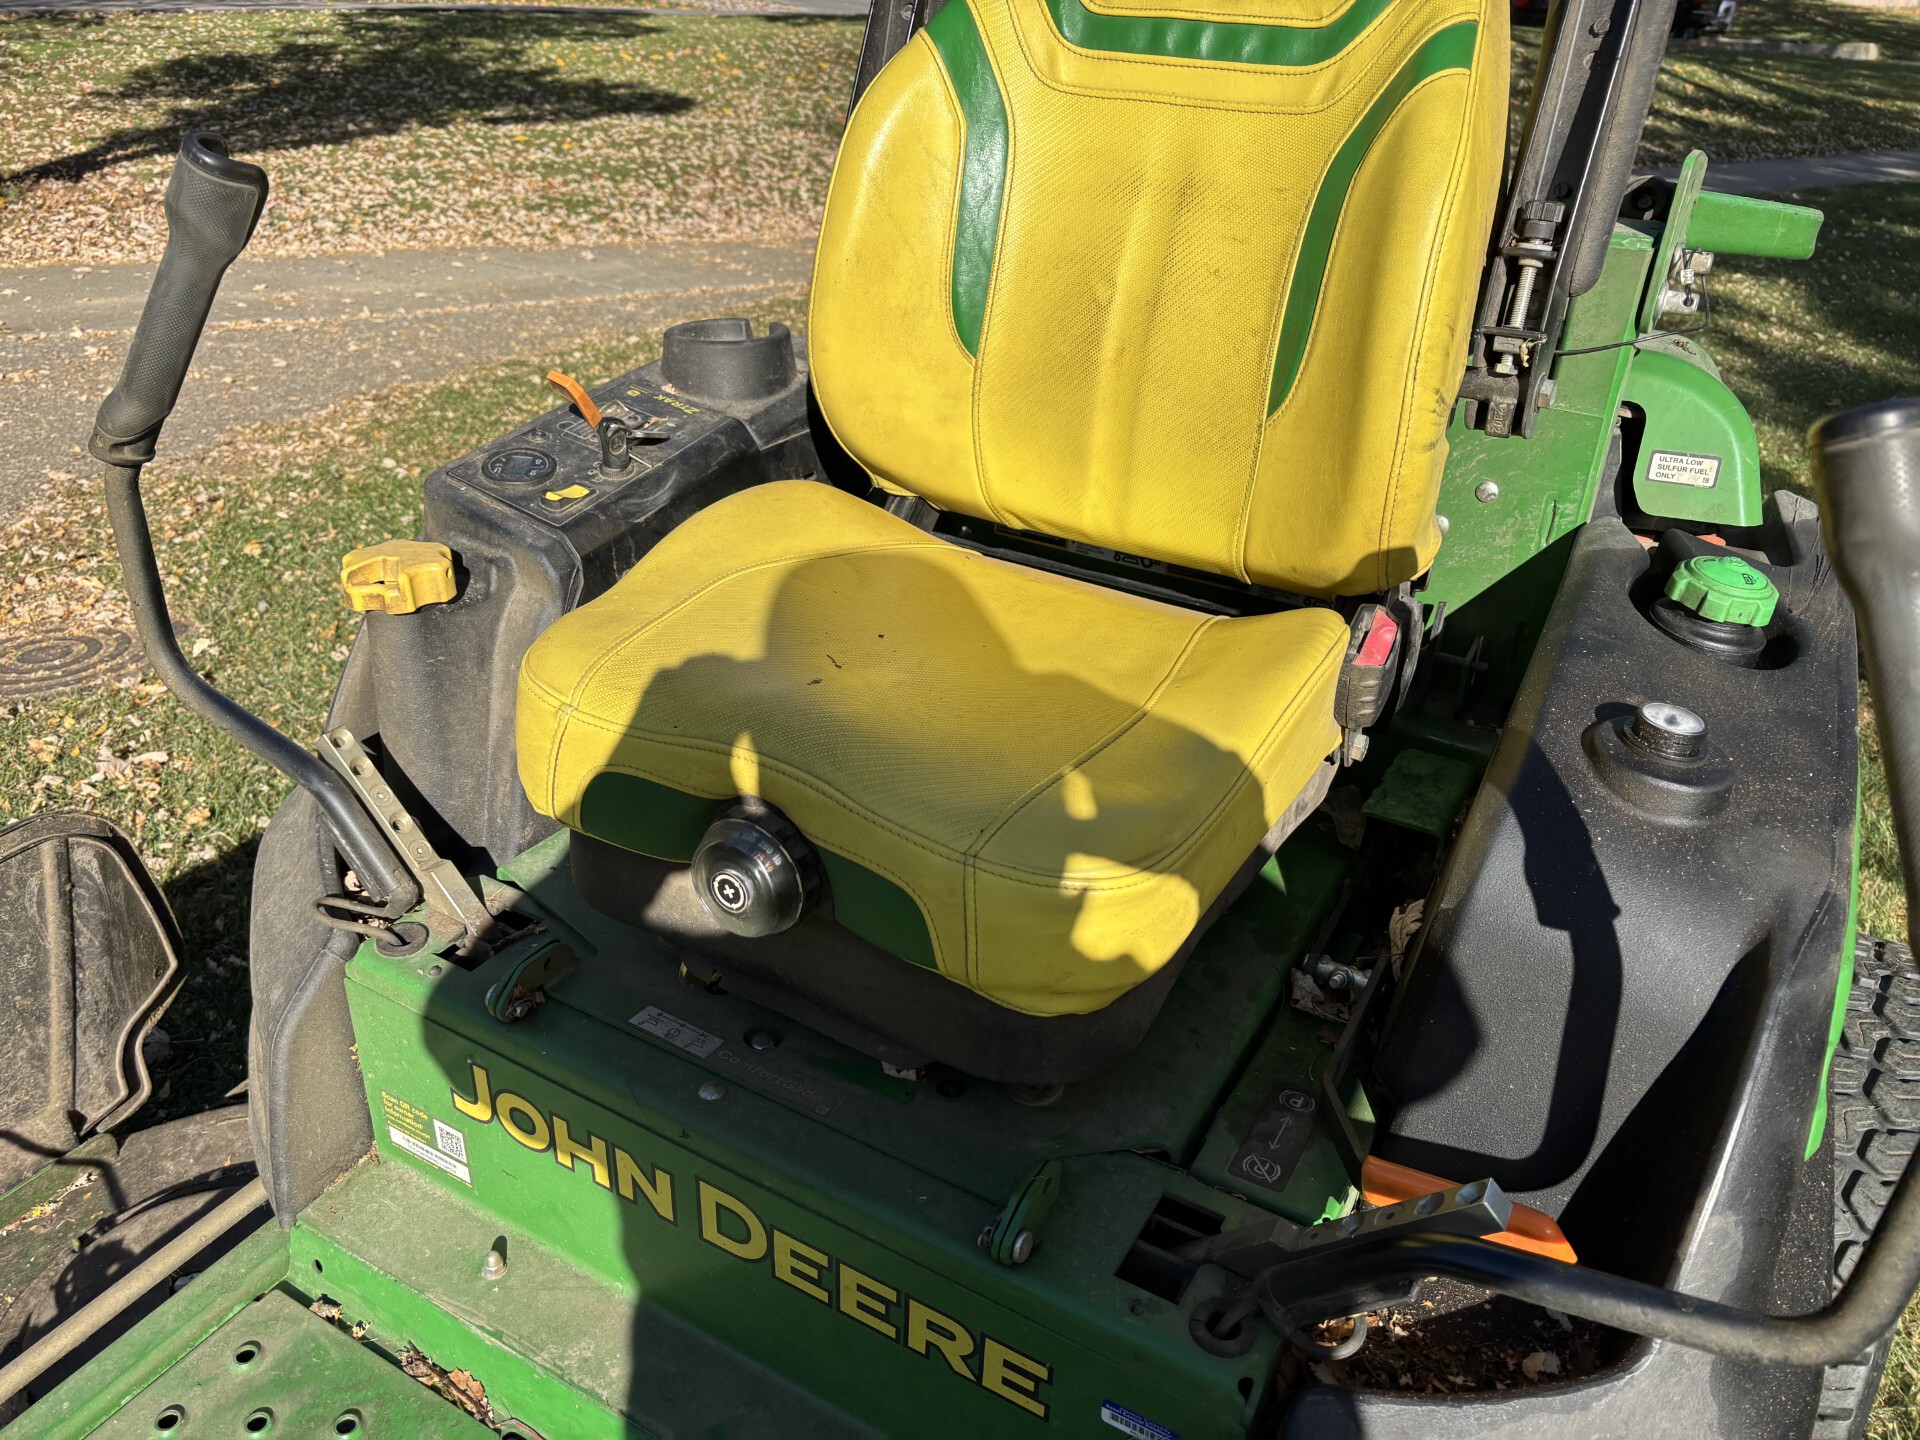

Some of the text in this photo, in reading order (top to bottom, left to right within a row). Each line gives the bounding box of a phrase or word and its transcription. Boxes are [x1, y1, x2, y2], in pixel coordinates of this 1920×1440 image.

[653, 394, 700, 415] ZTRAK
[1657, 463, 1710, 476] SULFUR FUEL
[1659, 455, 1704, 467] ULTRA LOW
[1655, 472, 1676, 480] ONLY
[757, 840, 782, 866] 280 lb
[718, 1050, 823, 1102] ComfortGlide
[381, 1090, 429, 1120] Scan QR code
[383, 1098, 414, 1119] for owner
[451, 1063, 1053, 1422] JOHN DEERE
